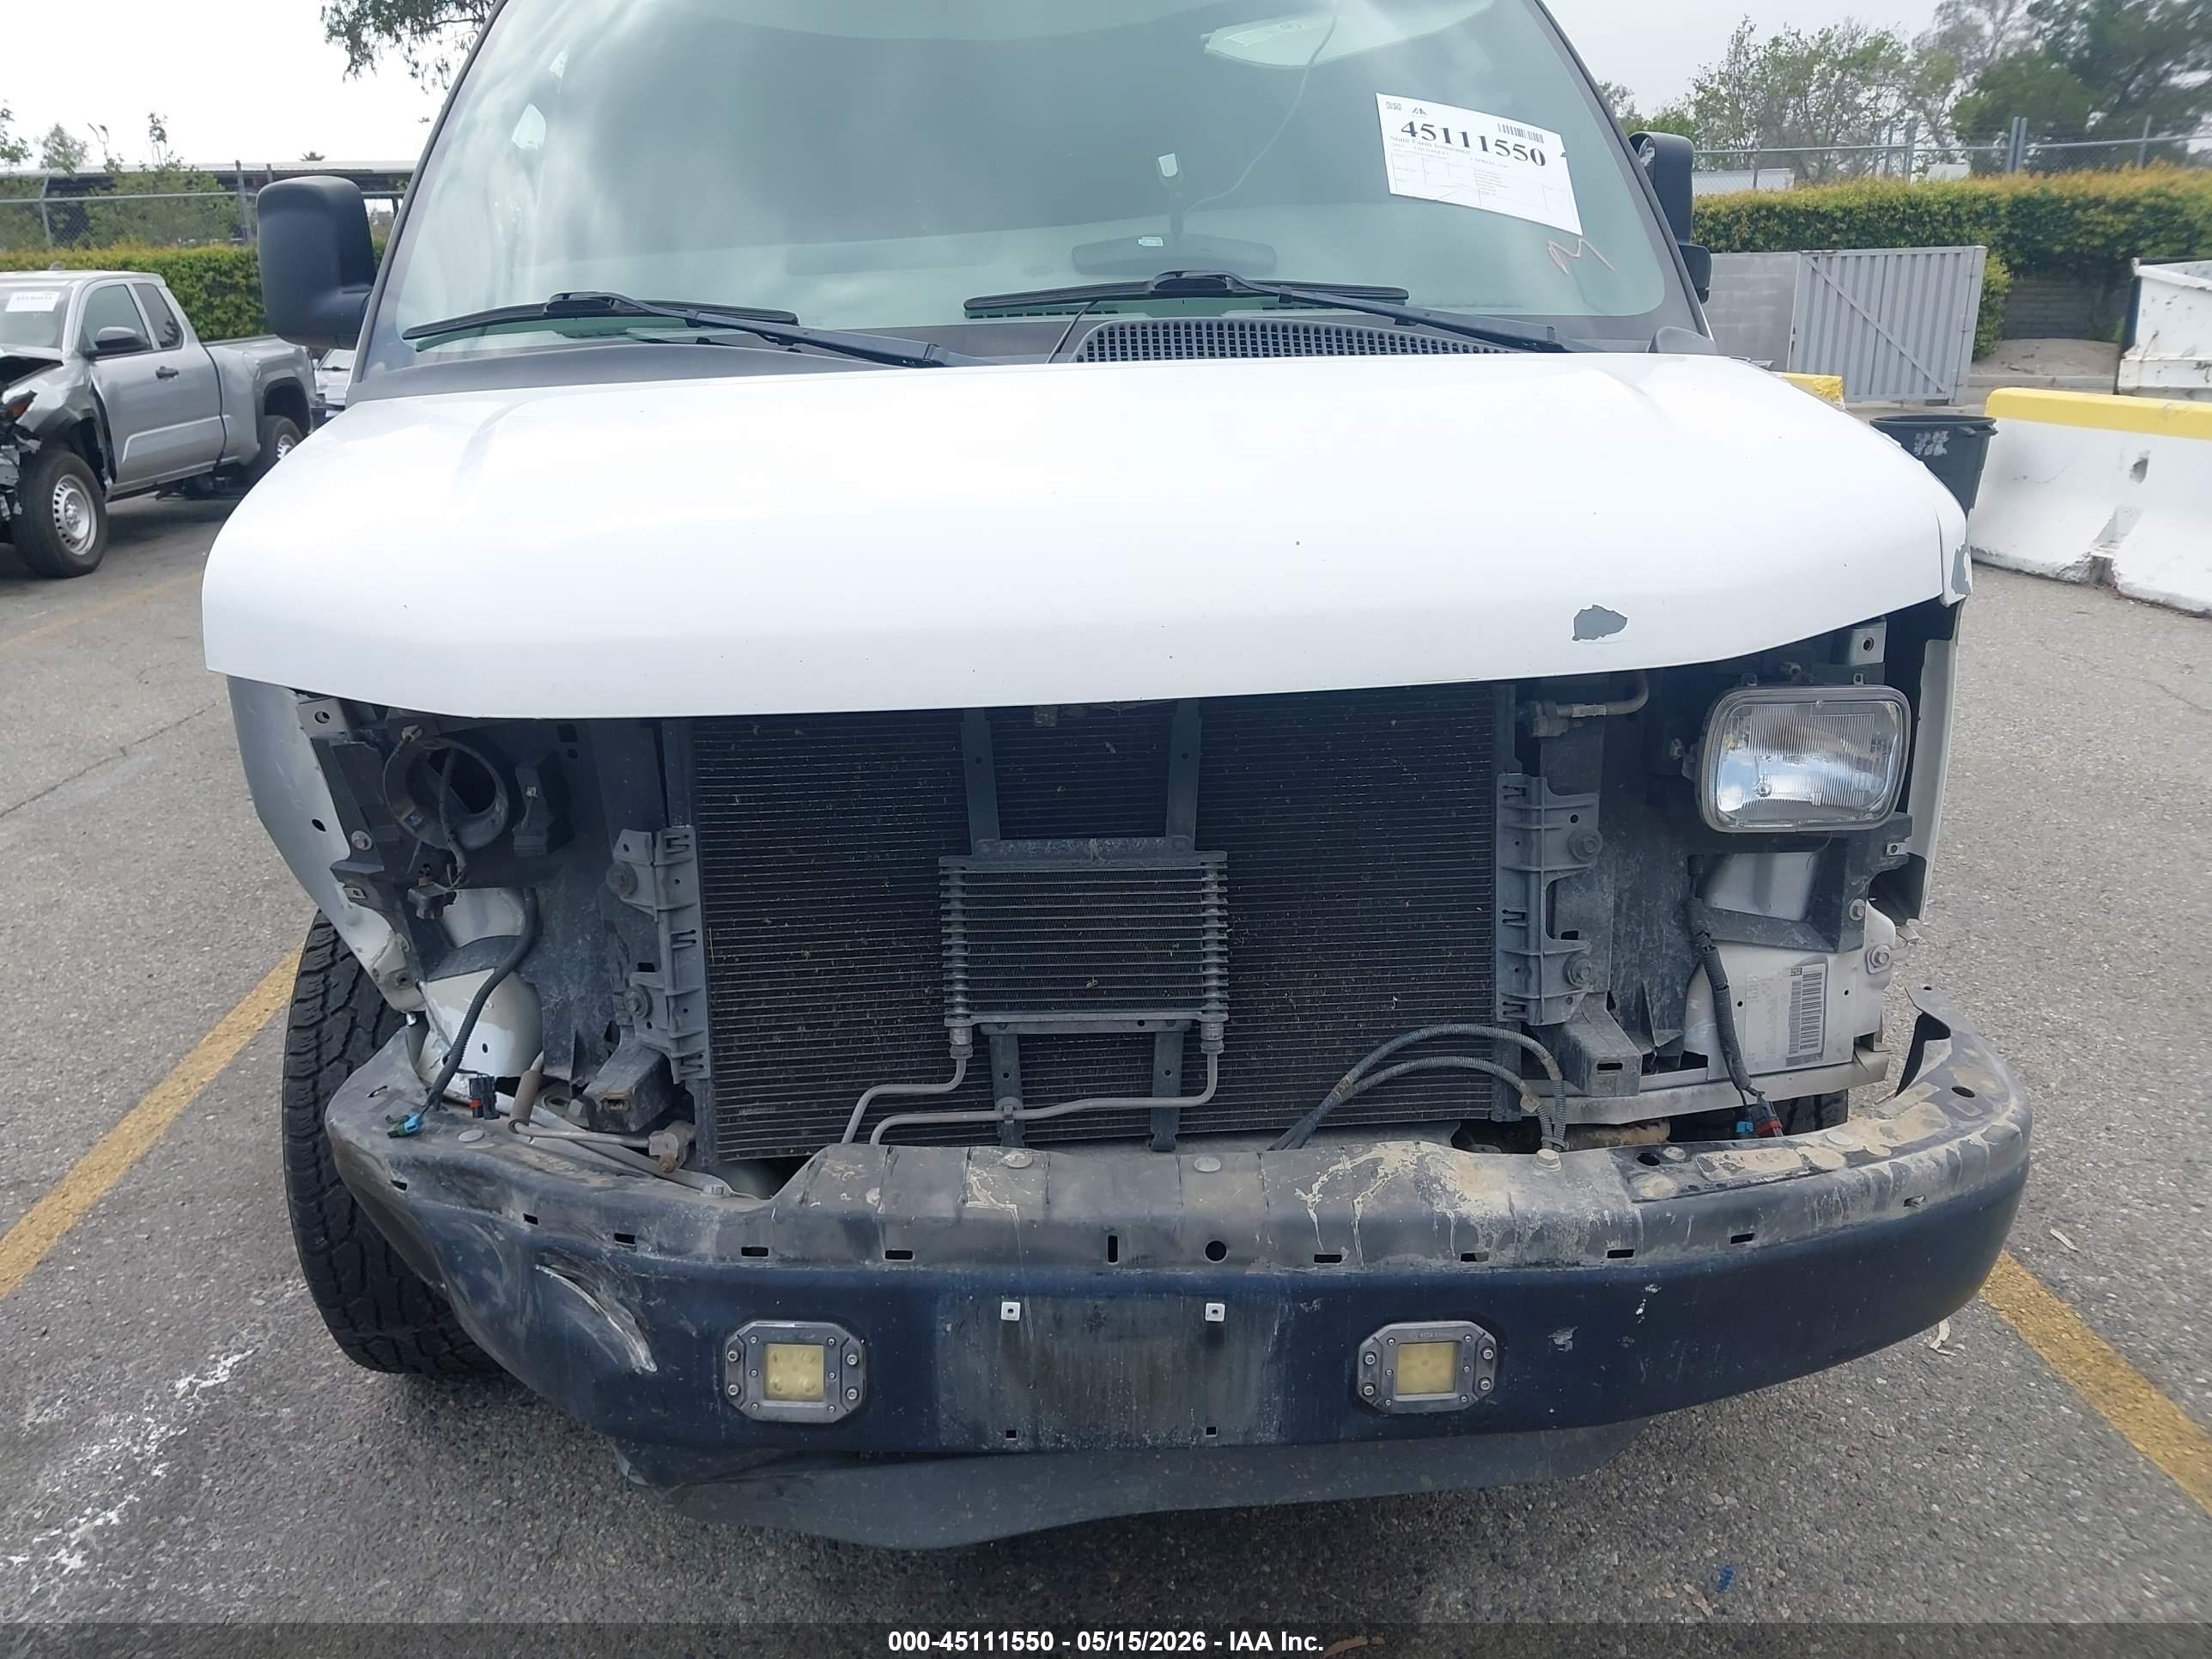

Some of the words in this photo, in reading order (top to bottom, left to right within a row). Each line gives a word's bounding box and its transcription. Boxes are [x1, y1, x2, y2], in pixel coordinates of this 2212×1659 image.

[1389, 135, 1410, 144] State
[1412, 137, 1432, 149] Farm
[1401, 120, 1547, 167] 45111550
